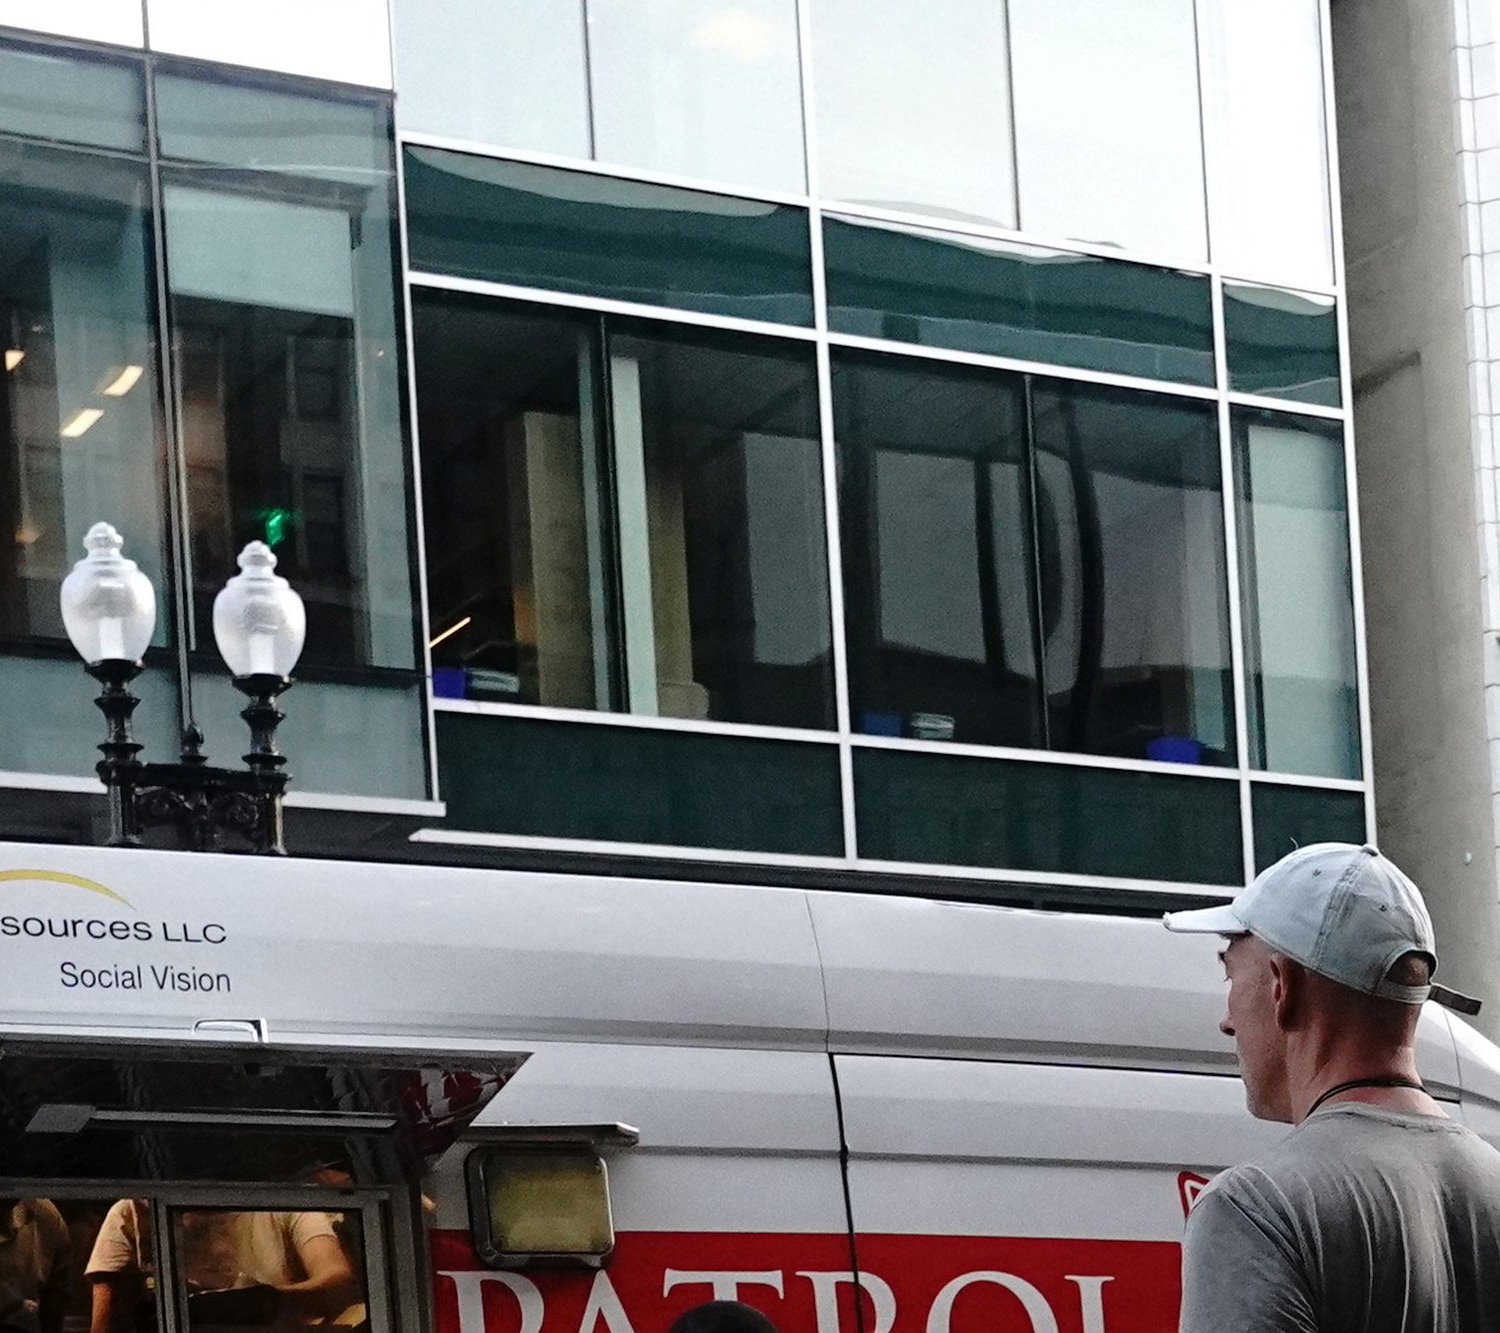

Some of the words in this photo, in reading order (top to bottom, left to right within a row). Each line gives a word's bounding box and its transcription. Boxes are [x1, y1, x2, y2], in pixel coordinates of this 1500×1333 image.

[162, 922, 228, 944] LLC
[60, 962, 143, 990] Social
[150, 965, 232, 993] Vision
